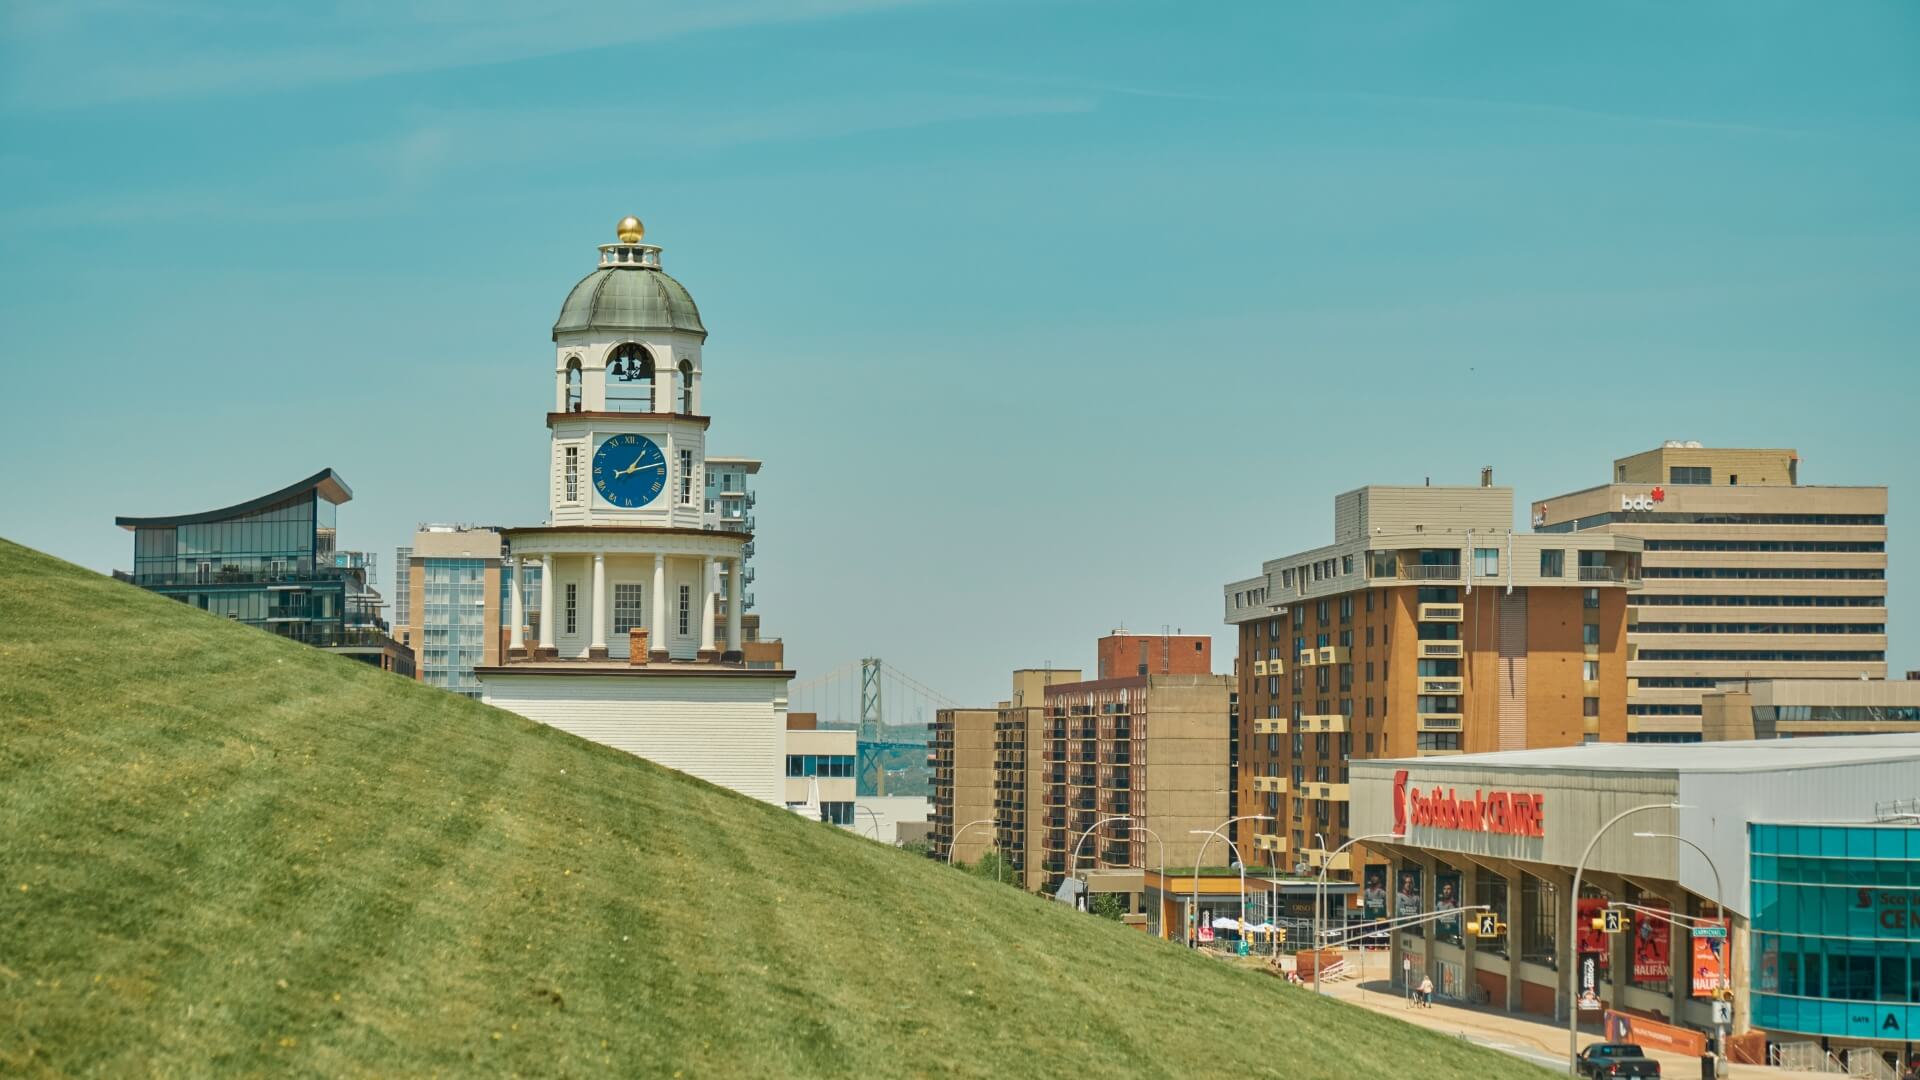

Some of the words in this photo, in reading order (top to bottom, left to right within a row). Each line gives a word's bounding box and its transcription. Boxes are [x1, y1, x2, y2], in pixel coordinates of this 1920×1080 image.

[609, 439, 619, 448] XI
[625, 436, 635, 444] XII
[652, 452, 661, 460] II
[1622, 494, 1653, 511] bdc
[1411, 785, 1487, 832] Scotiabank
[1487, 791, 1545, 838] CENTRE
[1240, 941, 1247, 949] P
[1634, 965, 1669, 976] HALIFAX
[1693, 979, 1729, 990] HALIFX
[1882, 1012, 1900, 1030] A
